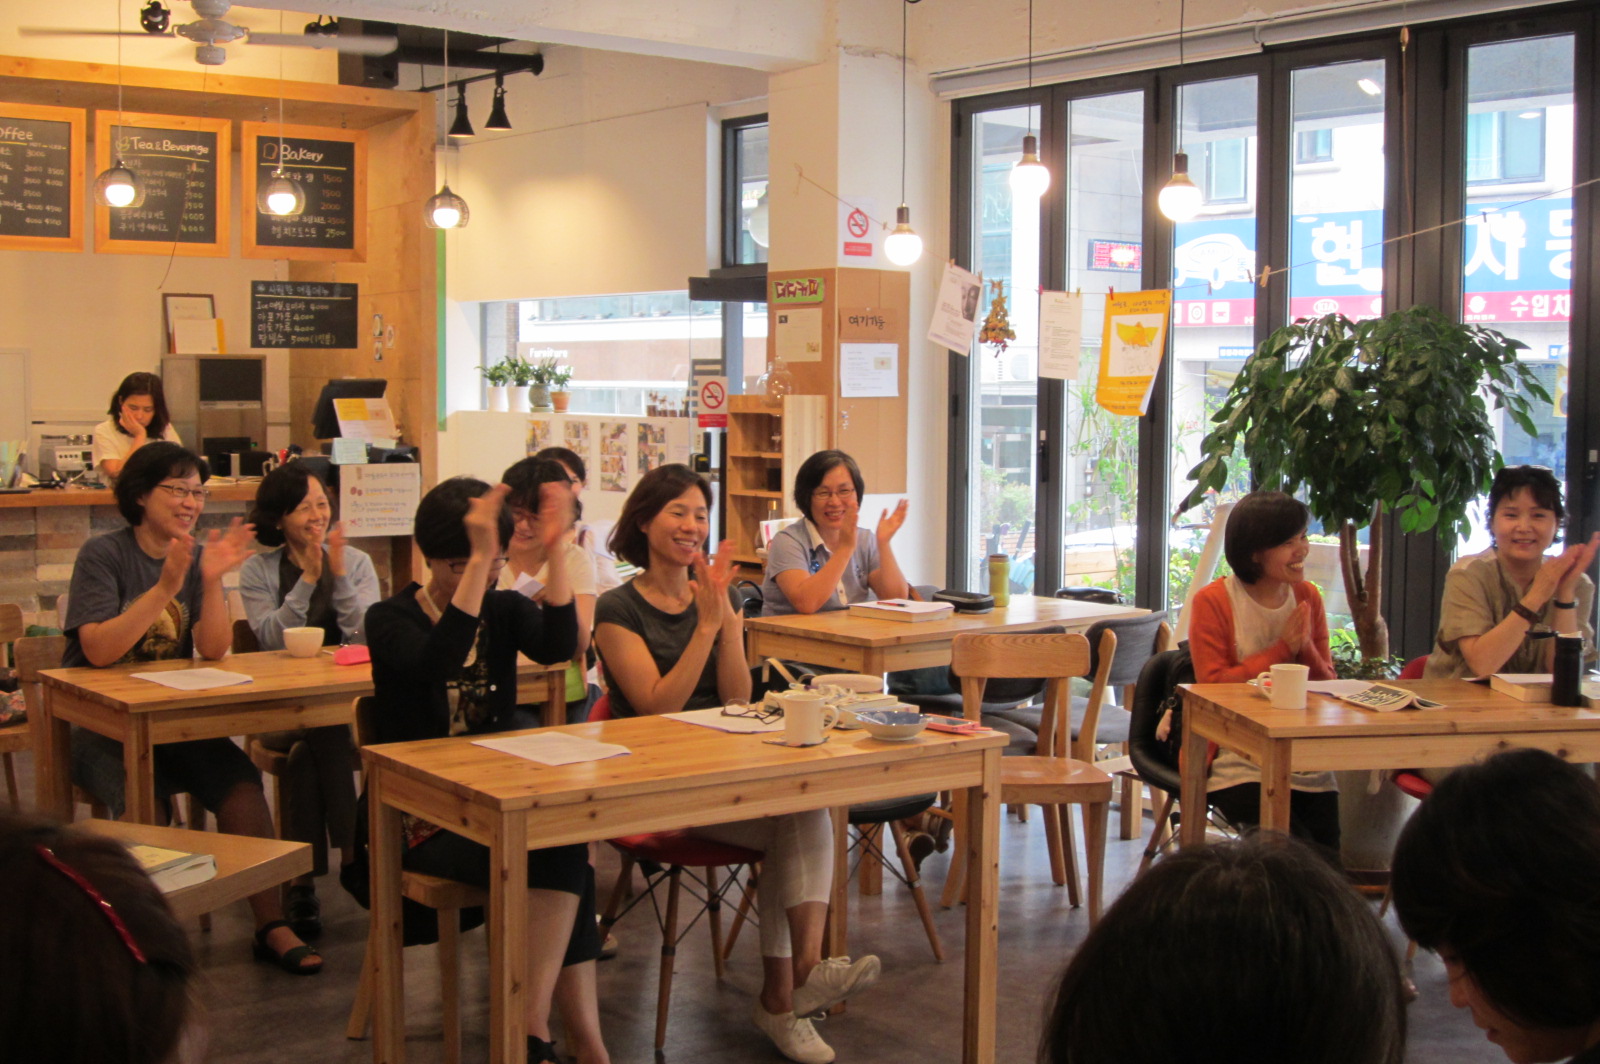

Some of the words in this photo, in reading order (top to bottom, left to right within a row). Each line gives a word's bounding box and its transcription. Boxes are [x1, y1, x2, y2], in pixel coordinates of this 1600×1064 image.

[130, 136, 154, 150] Tea
[162, 139, 209, 155] Beverage
[529, 347, 568, 358] Furniture
